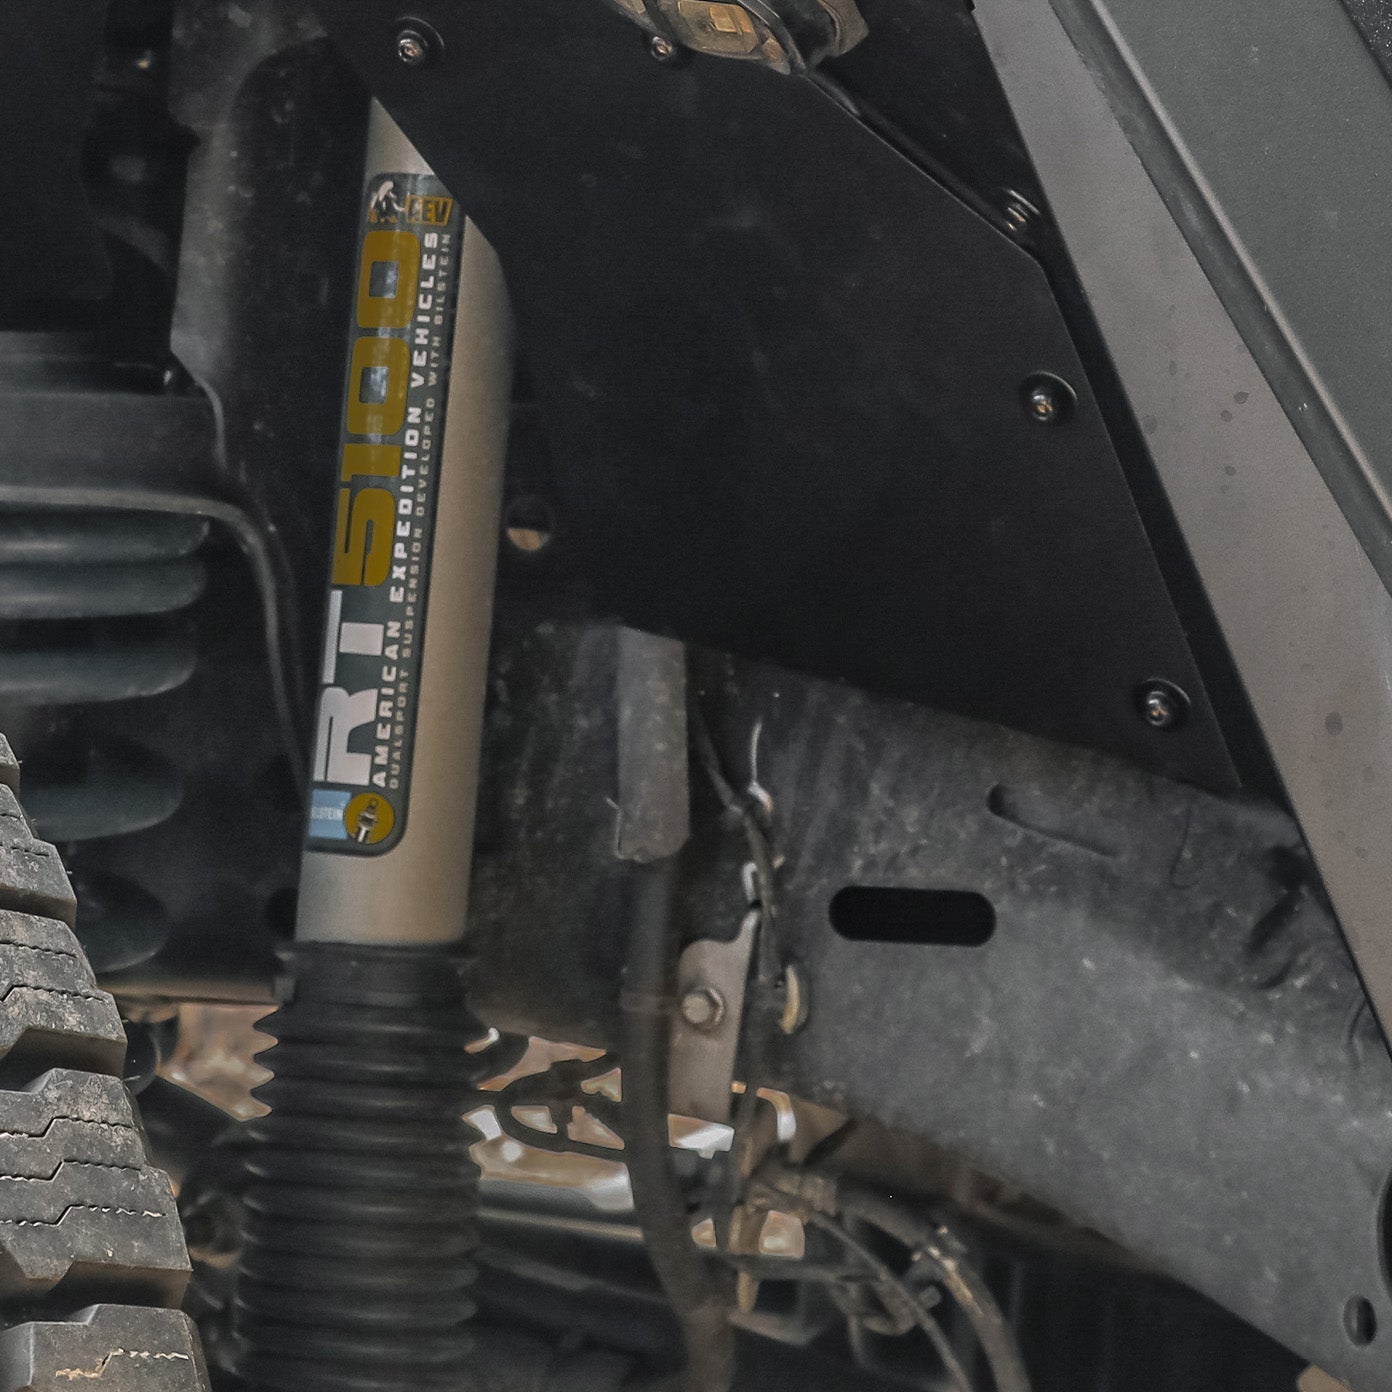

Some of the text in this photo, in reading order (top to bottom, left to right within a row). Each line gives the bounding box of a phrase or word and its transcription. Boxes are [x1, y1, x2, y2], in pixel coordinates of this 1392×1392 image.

[372, 232, 439, 788] AMERICAN EXPEDITION VEHICLES
[389, 234, 451, 789] DUALSPORT SUSPENSION DEVELOPED WITH BILSTEIN
